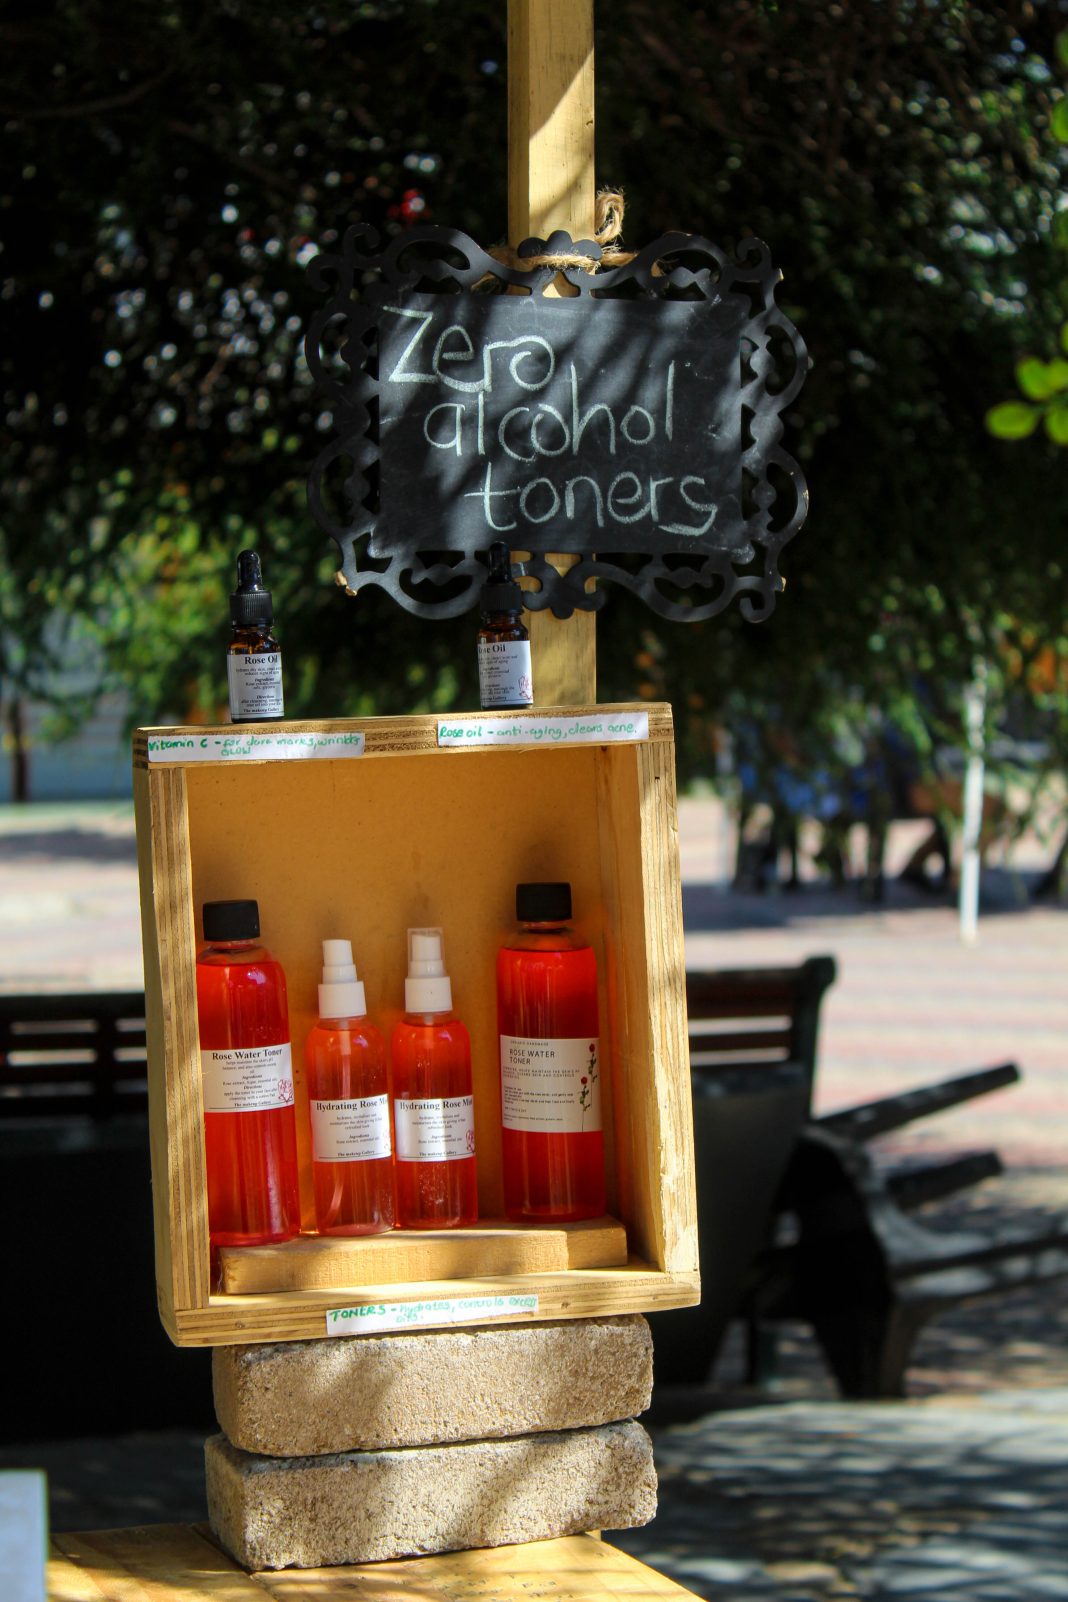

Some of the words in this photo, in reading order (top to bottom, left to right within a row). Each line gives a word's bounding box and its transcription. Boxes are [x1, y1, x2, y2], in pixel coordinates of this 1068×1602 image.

[383, 306, 555, 392] Zero
[424, 360, 674, 462] alcohol
[464, 462, 718, 536] toners
[493, 644, 505, 653] Oil
[245, 656, 265, 664] Rose
[467, 726, 482, 737] oil
[212, 1052, 232, 1060] Rose
[235, 1051, 260, 1059] Water
[263, 1048, 282, 1057] Toner
[316, 1102, 357, 1112] Hydrating
[360, 1100, 377, 1108] Rose
[400, 1102, 440, 1111] Hydrating
[329, 1305, 385, 1322] TONERS
